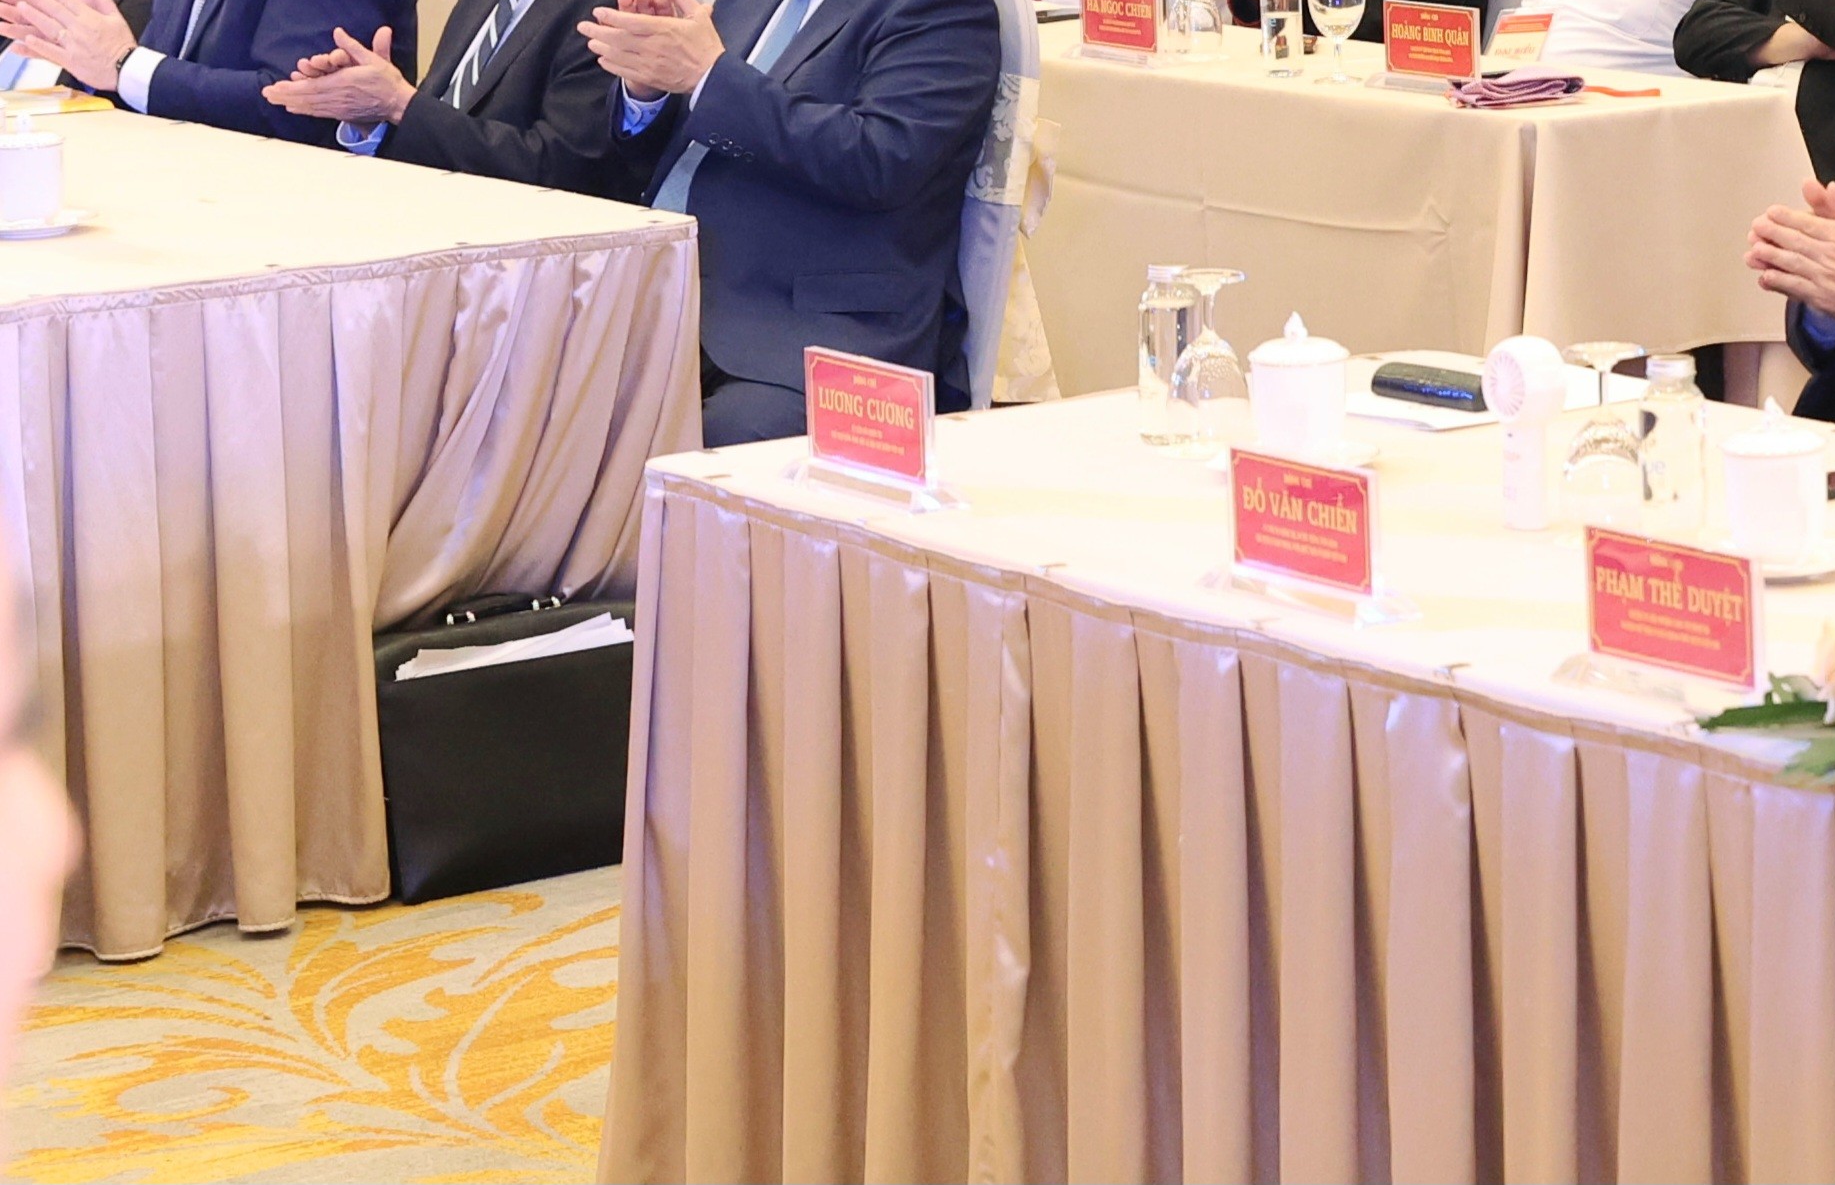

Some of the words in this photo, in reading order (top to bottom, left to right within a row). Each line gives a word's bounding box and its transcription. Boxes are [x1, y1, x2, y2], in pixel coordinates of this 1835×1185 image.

[1391, 19, 1421, 42] HOÀNG
[818, 386, 863, 418] LƯƠNG
[867, 396, 915, 430] CƯỜNG
[1269, 490, 1304, 523] VĂN
[1595, 566, 1645, 605] PHẠM
[1687, 586, 1743, 627] DUYỆT
